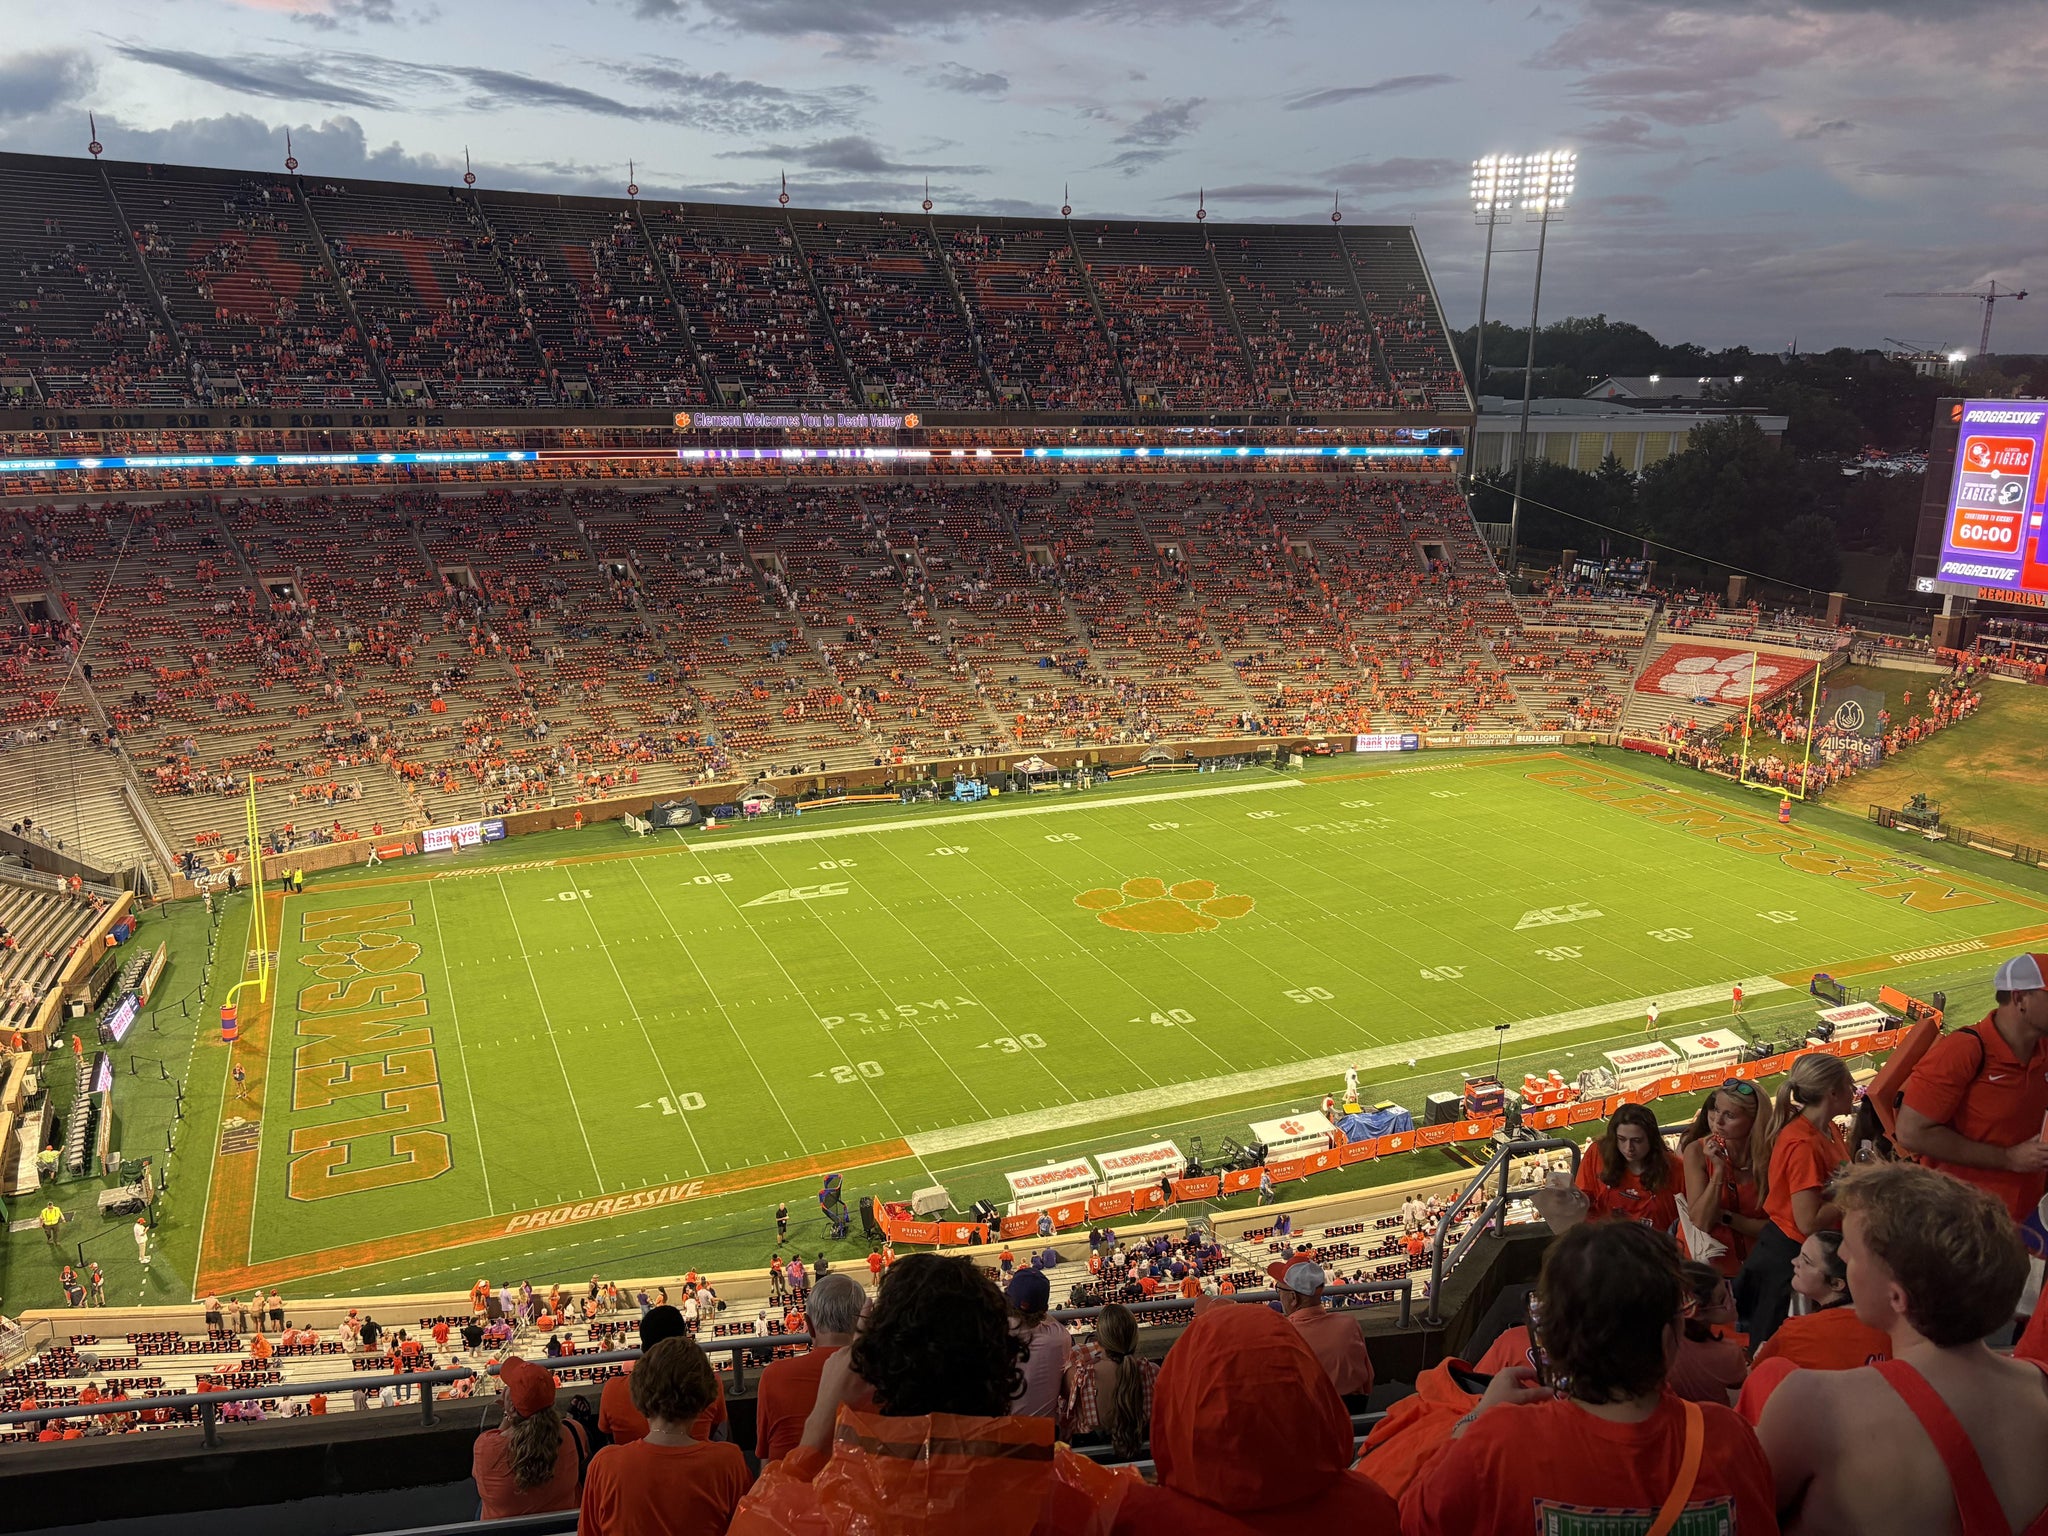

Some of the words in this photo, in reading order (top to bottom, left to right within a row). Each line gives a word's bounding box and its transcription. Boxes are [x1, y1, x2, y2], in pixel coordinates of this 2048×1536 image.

[693, 412, 741, 427] Clemson
[743, 412, 800, 427] Welcomes
[801, 413, 821, 427] You
[823, 414, 834, 427] to
[838, 413, 868, 427] Death
[870, 414, 902, 430] Valley
[1138, 415, 1204, 426] CHAMPIONS
[1965, 410, 2045, 424] PROGRESSIVE
[1993, 451, 2029, 467] TIGERS
[1961, 486, 1997, 502] EAGLES
[1960, 524, 2012, 543] 60:00
[1941, 561, 2019, 581] PROGRESSIVE
[1978, 587, 2045, 607] MEMORIAL
[1517, 735, 1536, 743] BUD
[1819, 734, 1872, 756] Allstate
[1390, 762, 1464, 775] PROGRESSIVE
[1045, 833, 1082, 844] 50
[935, 845, 970, 857] 40
[434, 860, 558, 878] PROGRESSIVE
[819, 857, 858, 872] 30
[692, 873, 734, 886] 20
[558, 888, 594, 901] 10
[738, 880, 852, 908] ACC
[1512, 902, 1605, 930] ACC
[1757, 910, 1796, 924] 10
[1647, 928, 1692, 943] 20
[1535, 946, 1579, 961] 30
[1889, 939, 1990, 965] PROGRESSIVE
[1420, 965, 1462, 982] 40
[1283, 985, 1336, 1004] 50
[820, 995, 979, 1030] PRISMA
[1149, 1008, 1197, 1027] 40
[860, 1012, 960, 1035] HEALTH
[993, 1033, 1048, 1054] 30
[829, 1060, 886, 1084] 20
[1535, 1095, 1543, 1104] G
[1556, 1090, 1565, 1100] G
[656, 1091, 707, 1116] 10
[1103, 1147, 1178, 1171] CLEMSON
[1013, 1164, 1091, 1189] CLEMSON
[1185, 1183, 1209, 1191] PRISMA
[505, 1180, 704, 1234] PROGRESSIVE
[1099, 1198, 1122, 1208] PRISMA
[901, 1227, 927, 1235] PRISMA
[1004, 1220, 1029, 1230] PRISMA
[1093, 1259, 1099, 1269] 9
